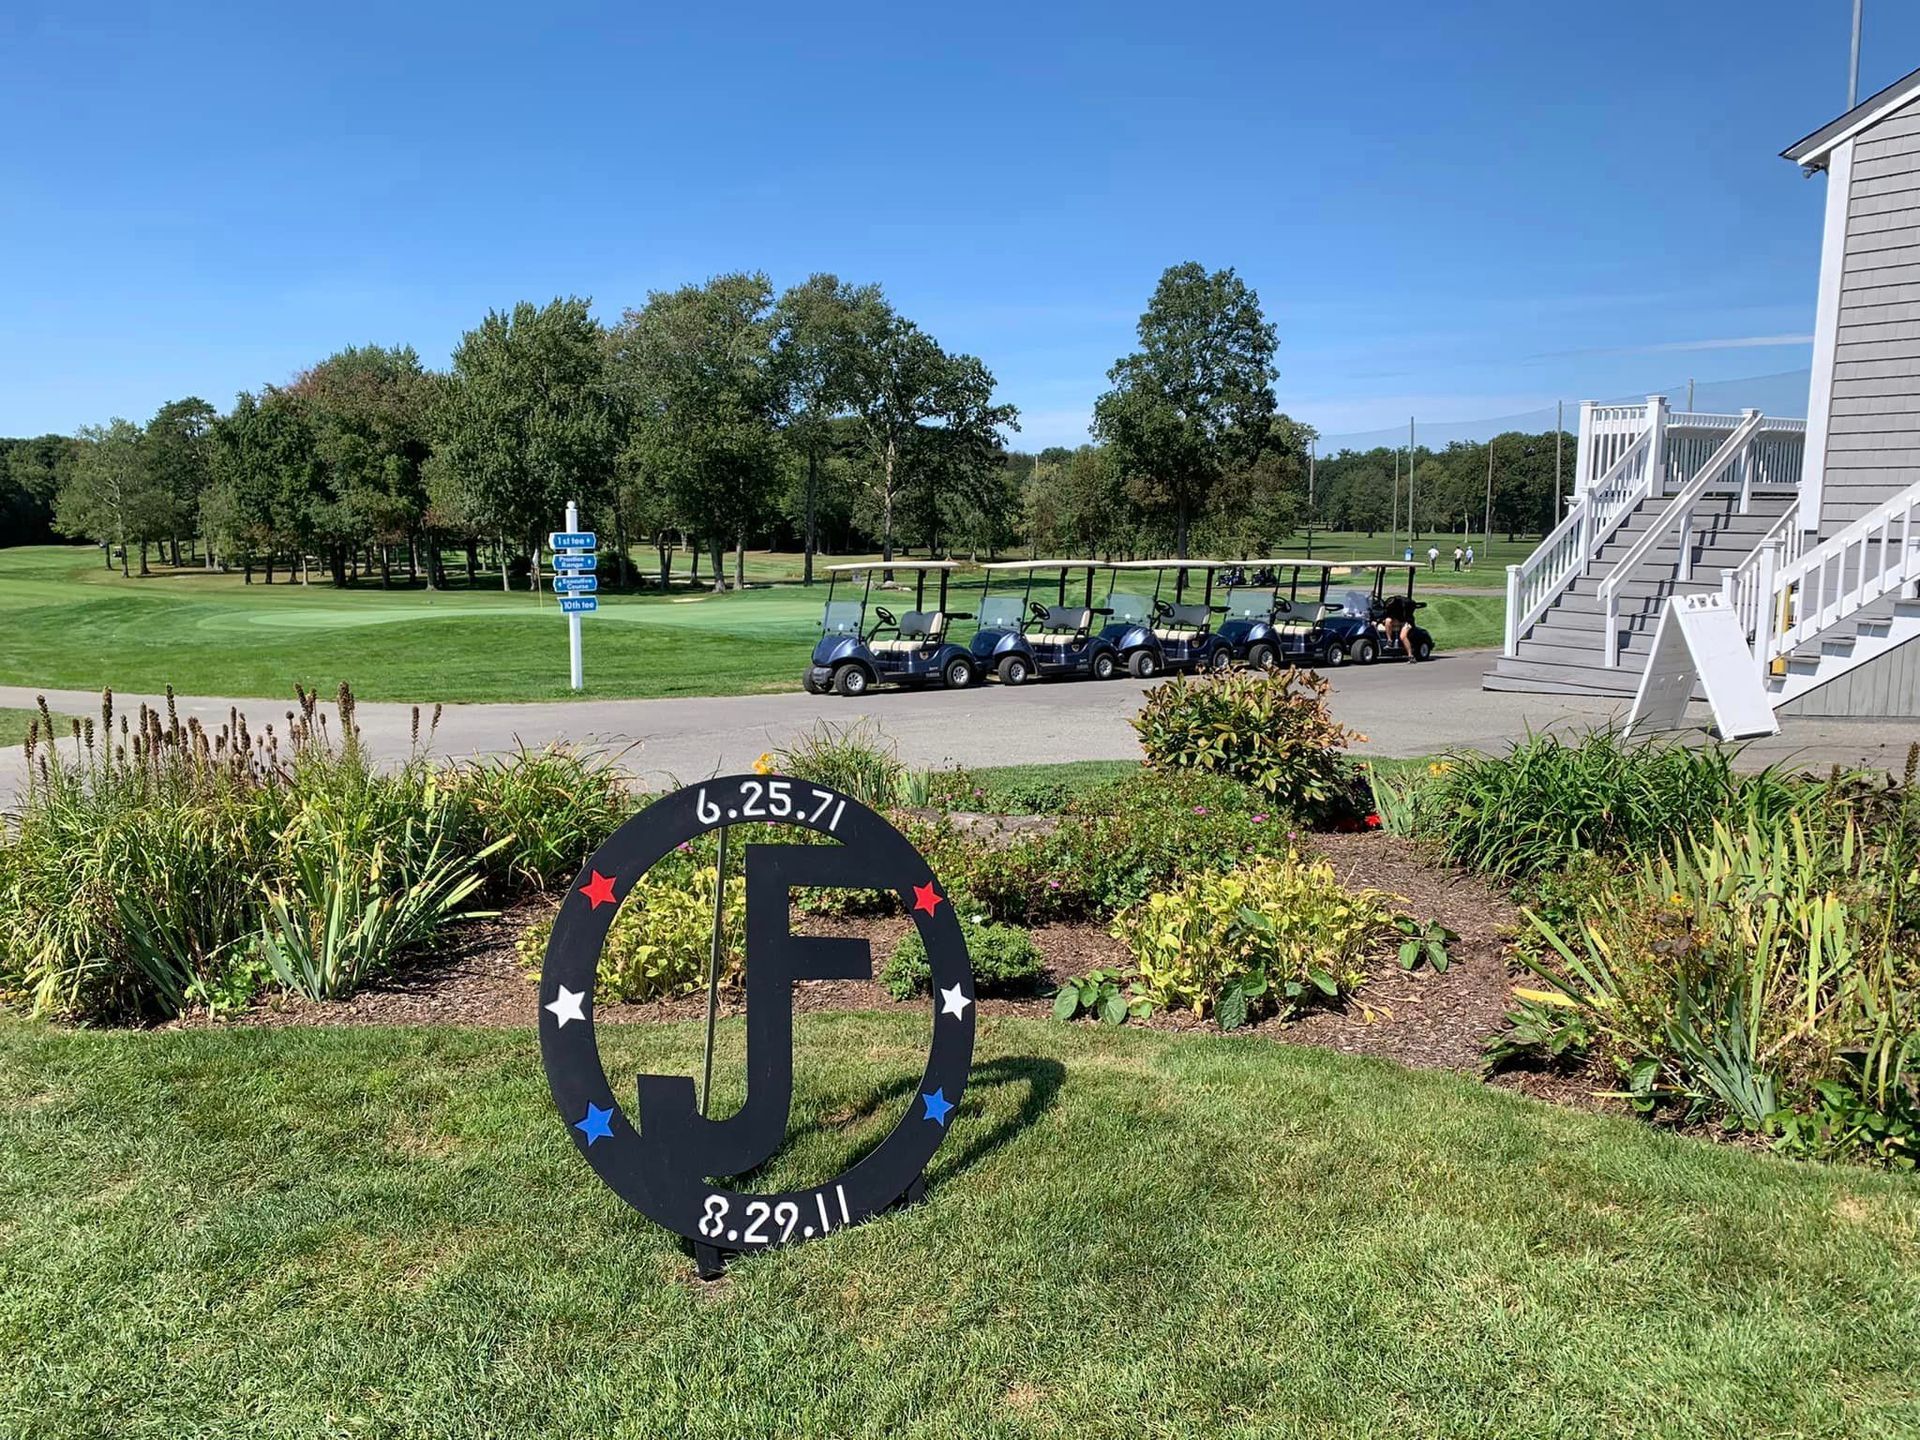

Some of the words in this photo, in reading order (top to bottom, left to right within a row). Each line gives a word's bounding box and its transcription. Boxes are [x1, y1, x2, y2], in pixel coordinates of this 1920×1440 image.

[557, 537, 570, 545] 1st
[571, 537, 585, 545] tee
[563, 600, 581, 610] 10th
[581, 600, 595, 609] tee
[696, 780, 847, 832] 6.25.71
[698, 1184, 851, 1244] 8.29.11
